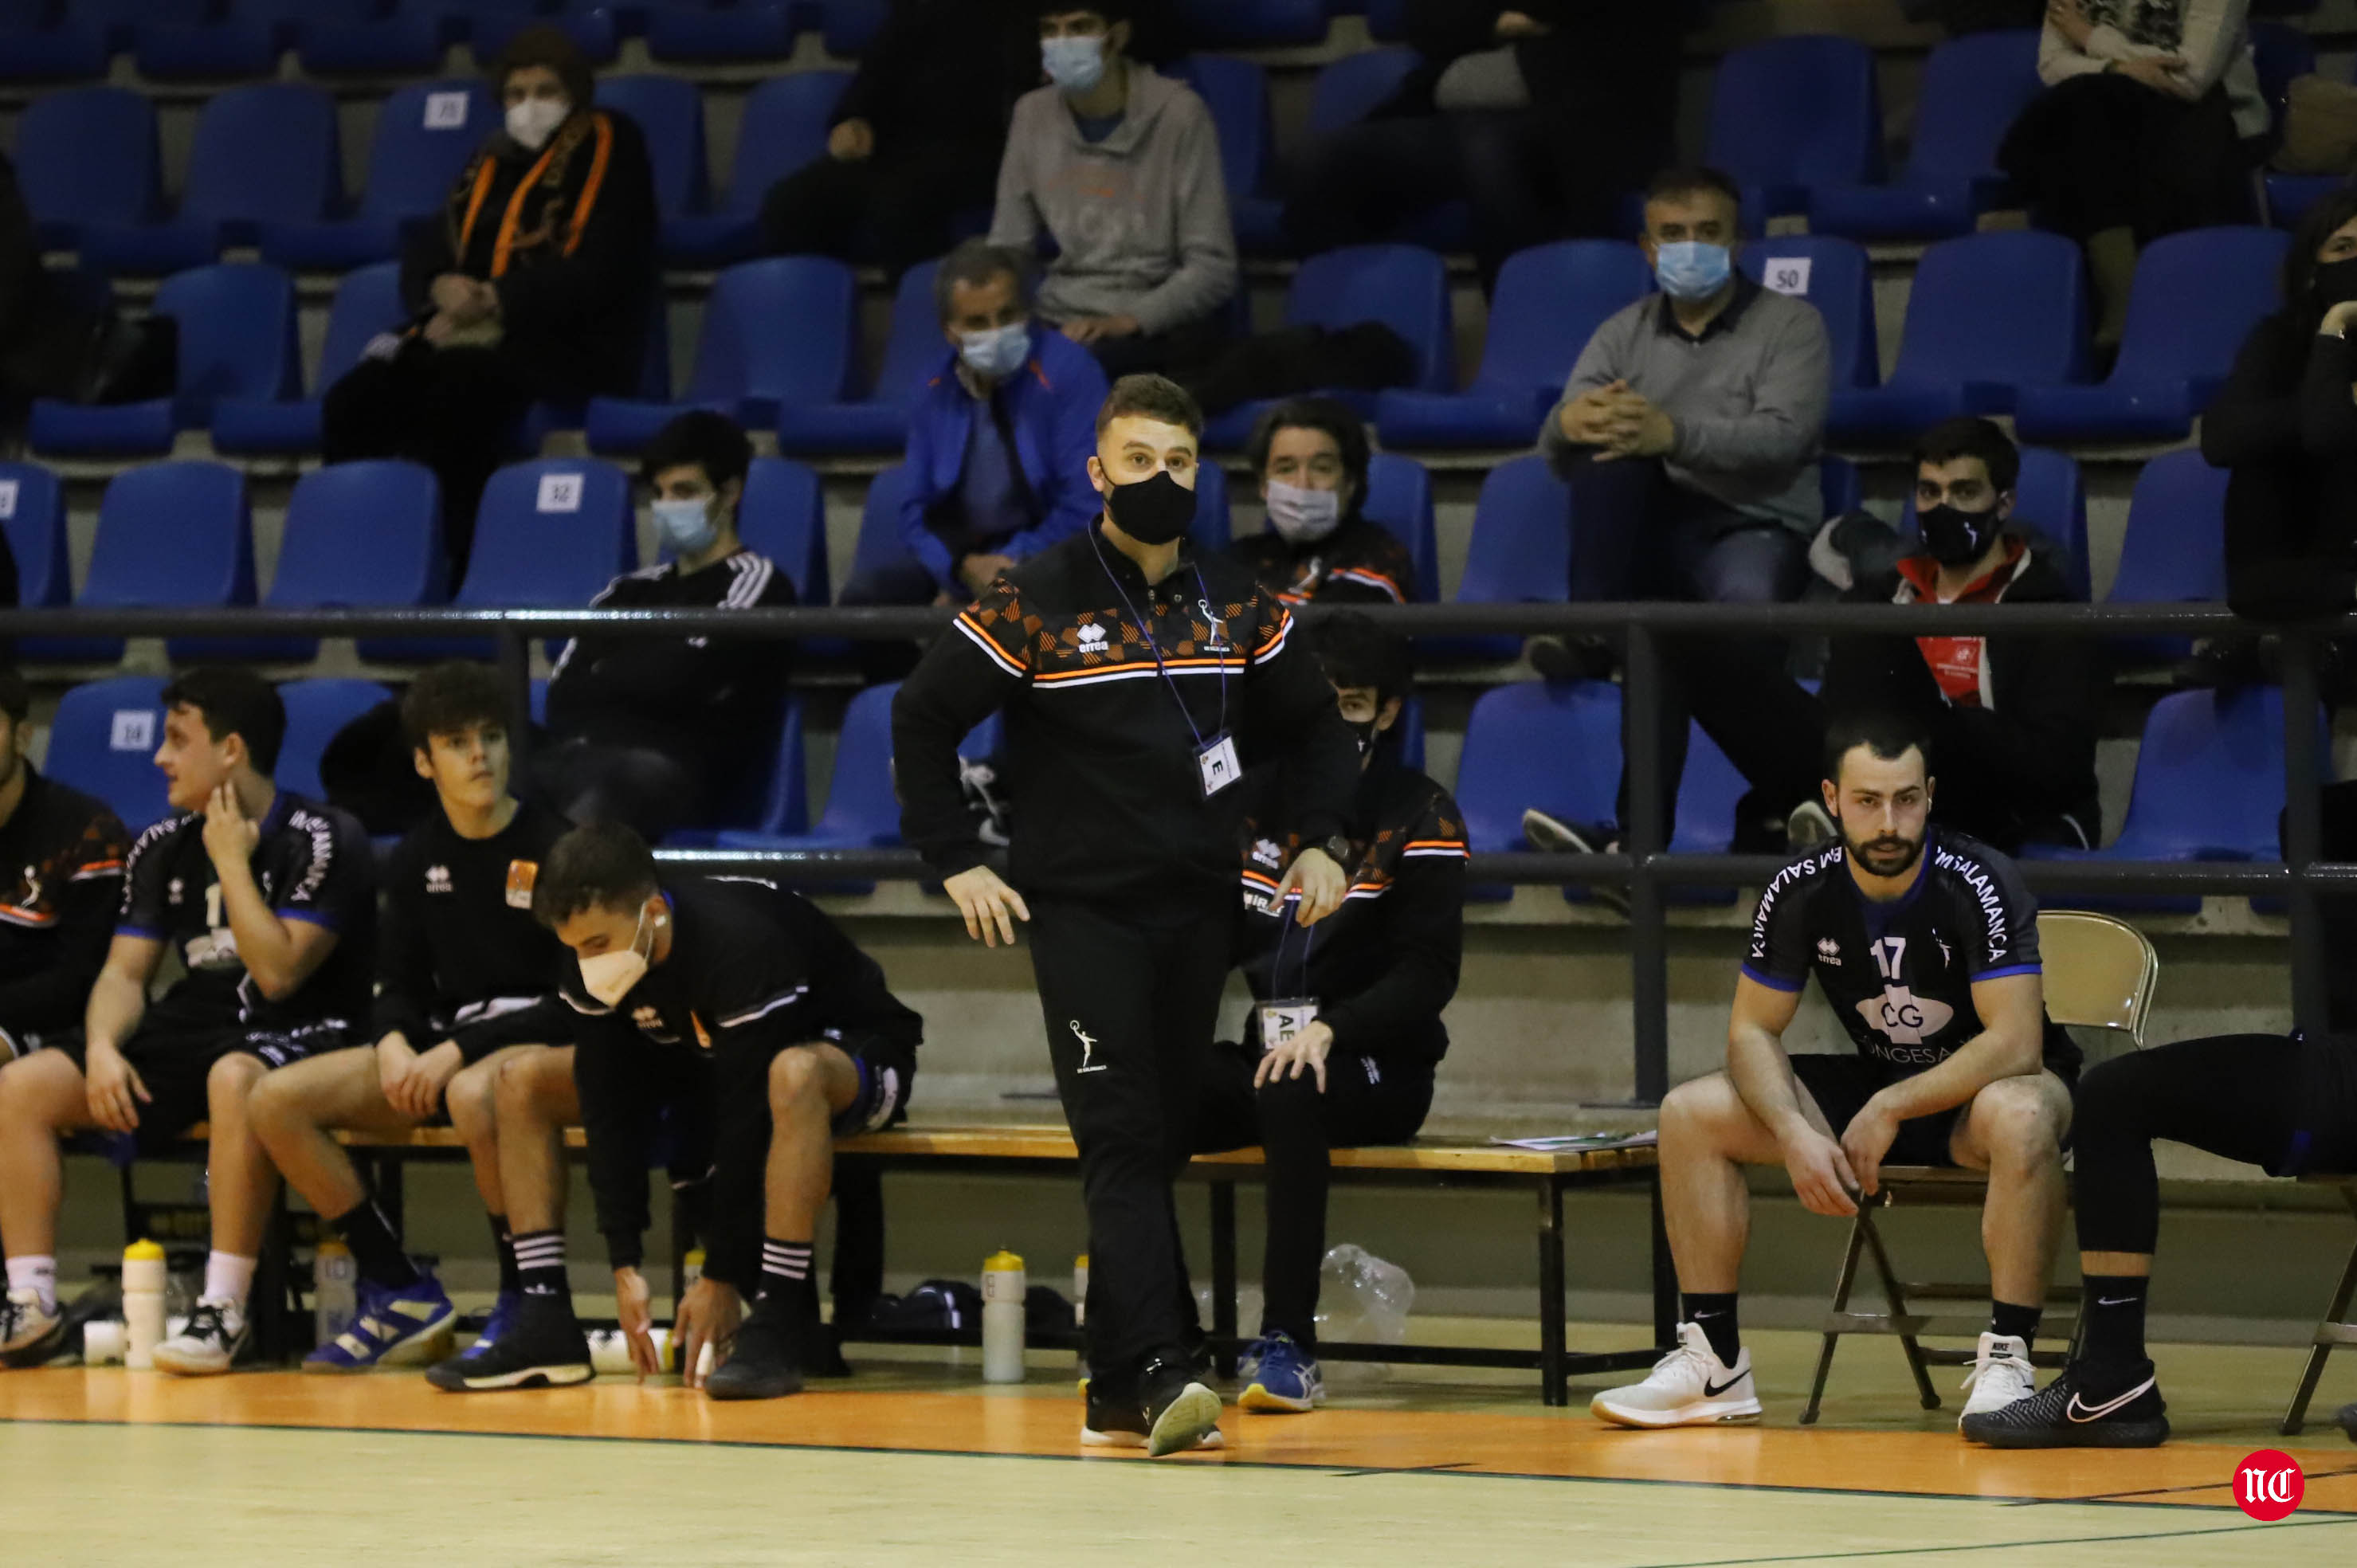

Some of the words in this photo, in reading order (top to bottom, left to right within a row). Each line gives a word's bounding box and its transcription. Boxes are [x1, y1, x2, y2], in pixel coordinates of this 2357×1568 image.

[1079, 640, 1109, 653] errea
[1211, 759, 1224, 776] E
[1869, 937, 1906, 979] 17
[1881, 1002, 1924, 1028] CG
